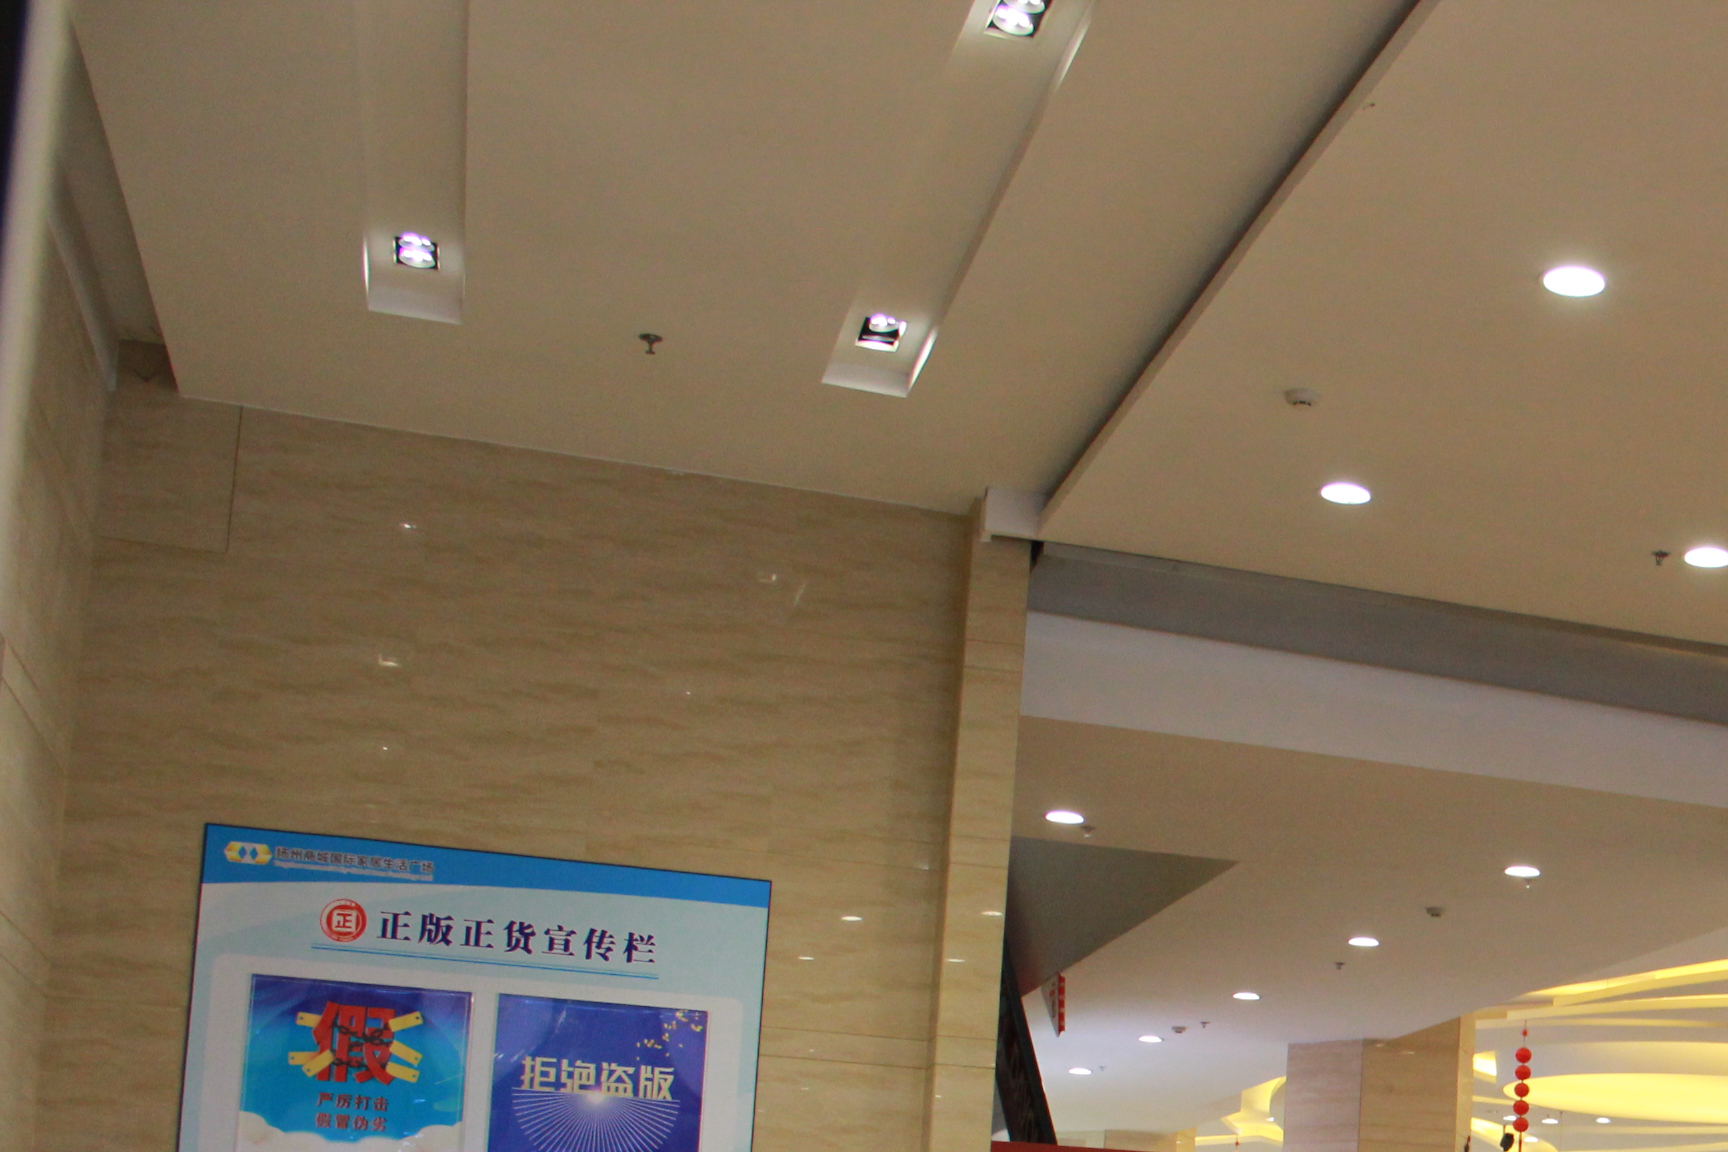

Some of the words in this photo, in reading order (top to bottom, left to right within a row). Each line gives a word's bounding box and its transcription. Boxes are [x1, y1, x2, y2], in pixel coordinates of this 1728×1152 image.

[377, 910, 657, 964] 正版正货宣传栏
[520, 1055, 675, 1101] 拒绝盗版
[316, 1092, 389, 1112] 严厉打击
[315, 1113, 388, 1133] 假冒伪劣
